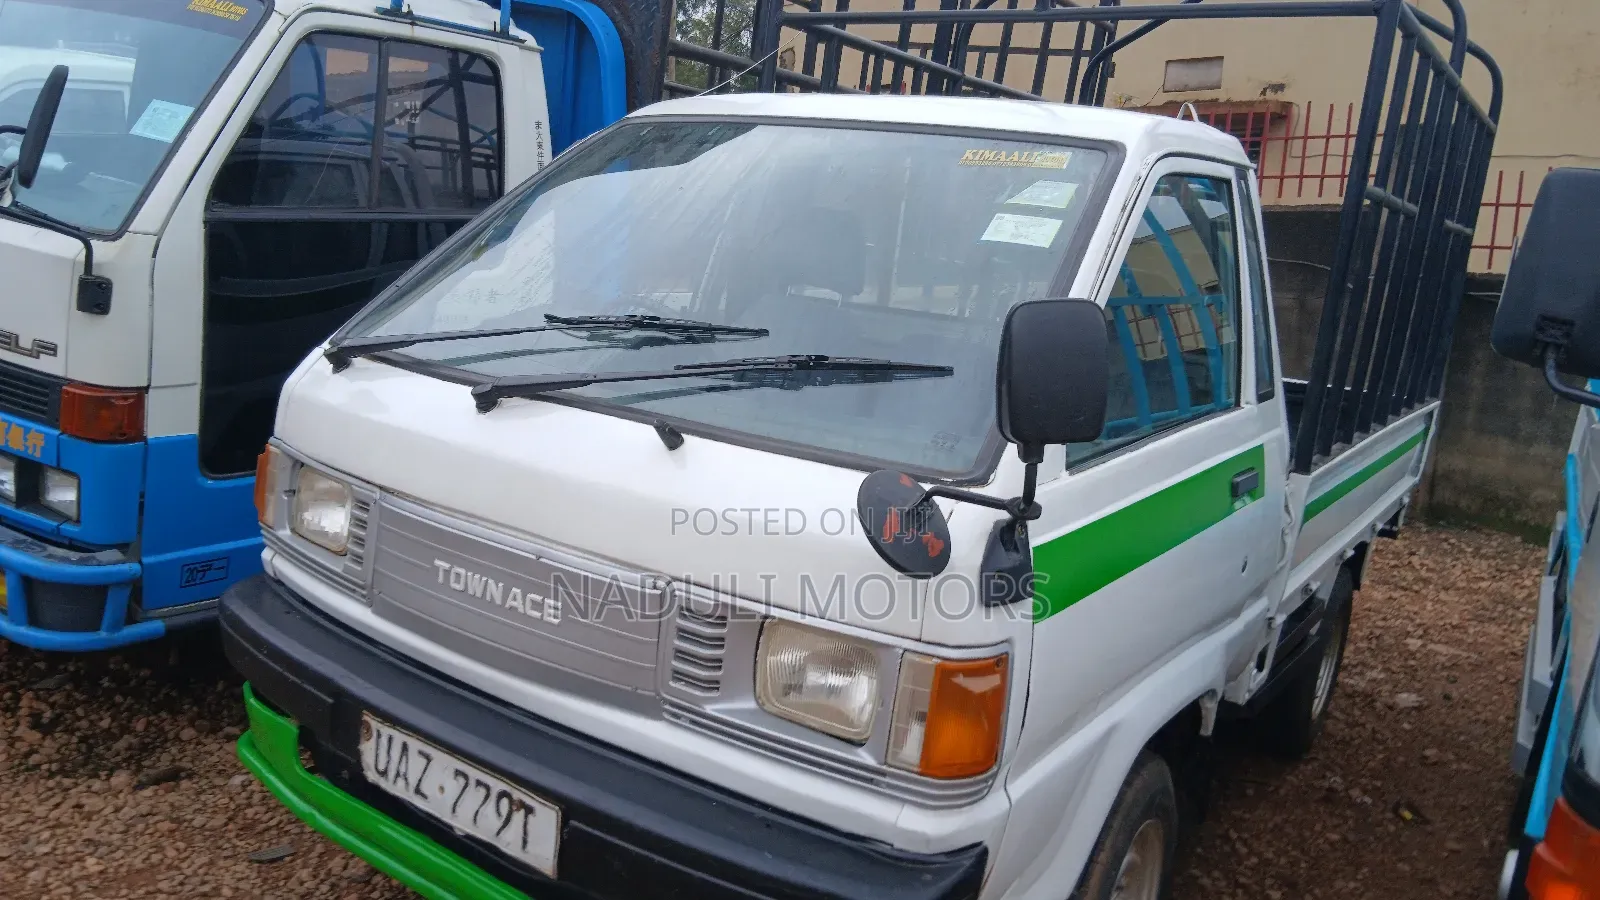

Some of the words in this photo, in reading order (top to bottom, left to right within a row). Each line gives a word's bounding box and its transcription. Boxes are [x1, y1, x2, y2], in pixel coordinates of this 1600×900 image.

[961, 149, 1041, 162] KIMAALI
[374, 729, 433, 801] UAZ
[452, 768, 537, 852] 779T
